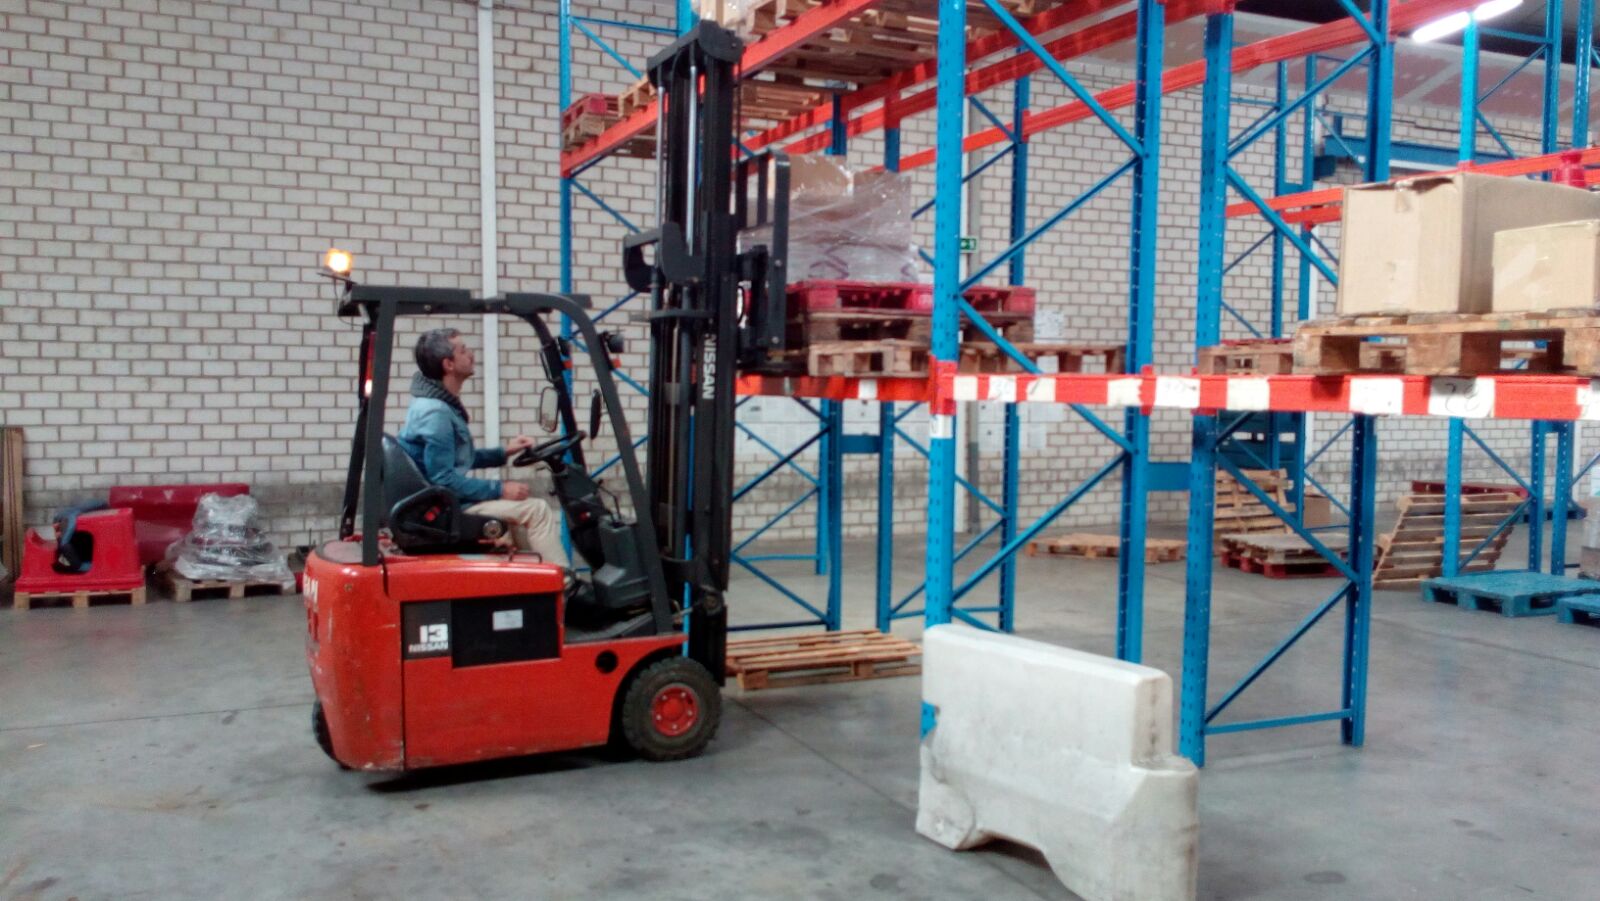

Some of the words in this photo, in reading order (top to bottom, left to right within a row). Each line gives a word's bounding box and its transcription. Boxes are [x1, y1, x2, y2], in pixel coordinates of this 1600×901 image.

[702, 333, 717, 400] NISSAN
[420, 624, 448, 643] 13
[408, 642, 449, 653] NISSAN
